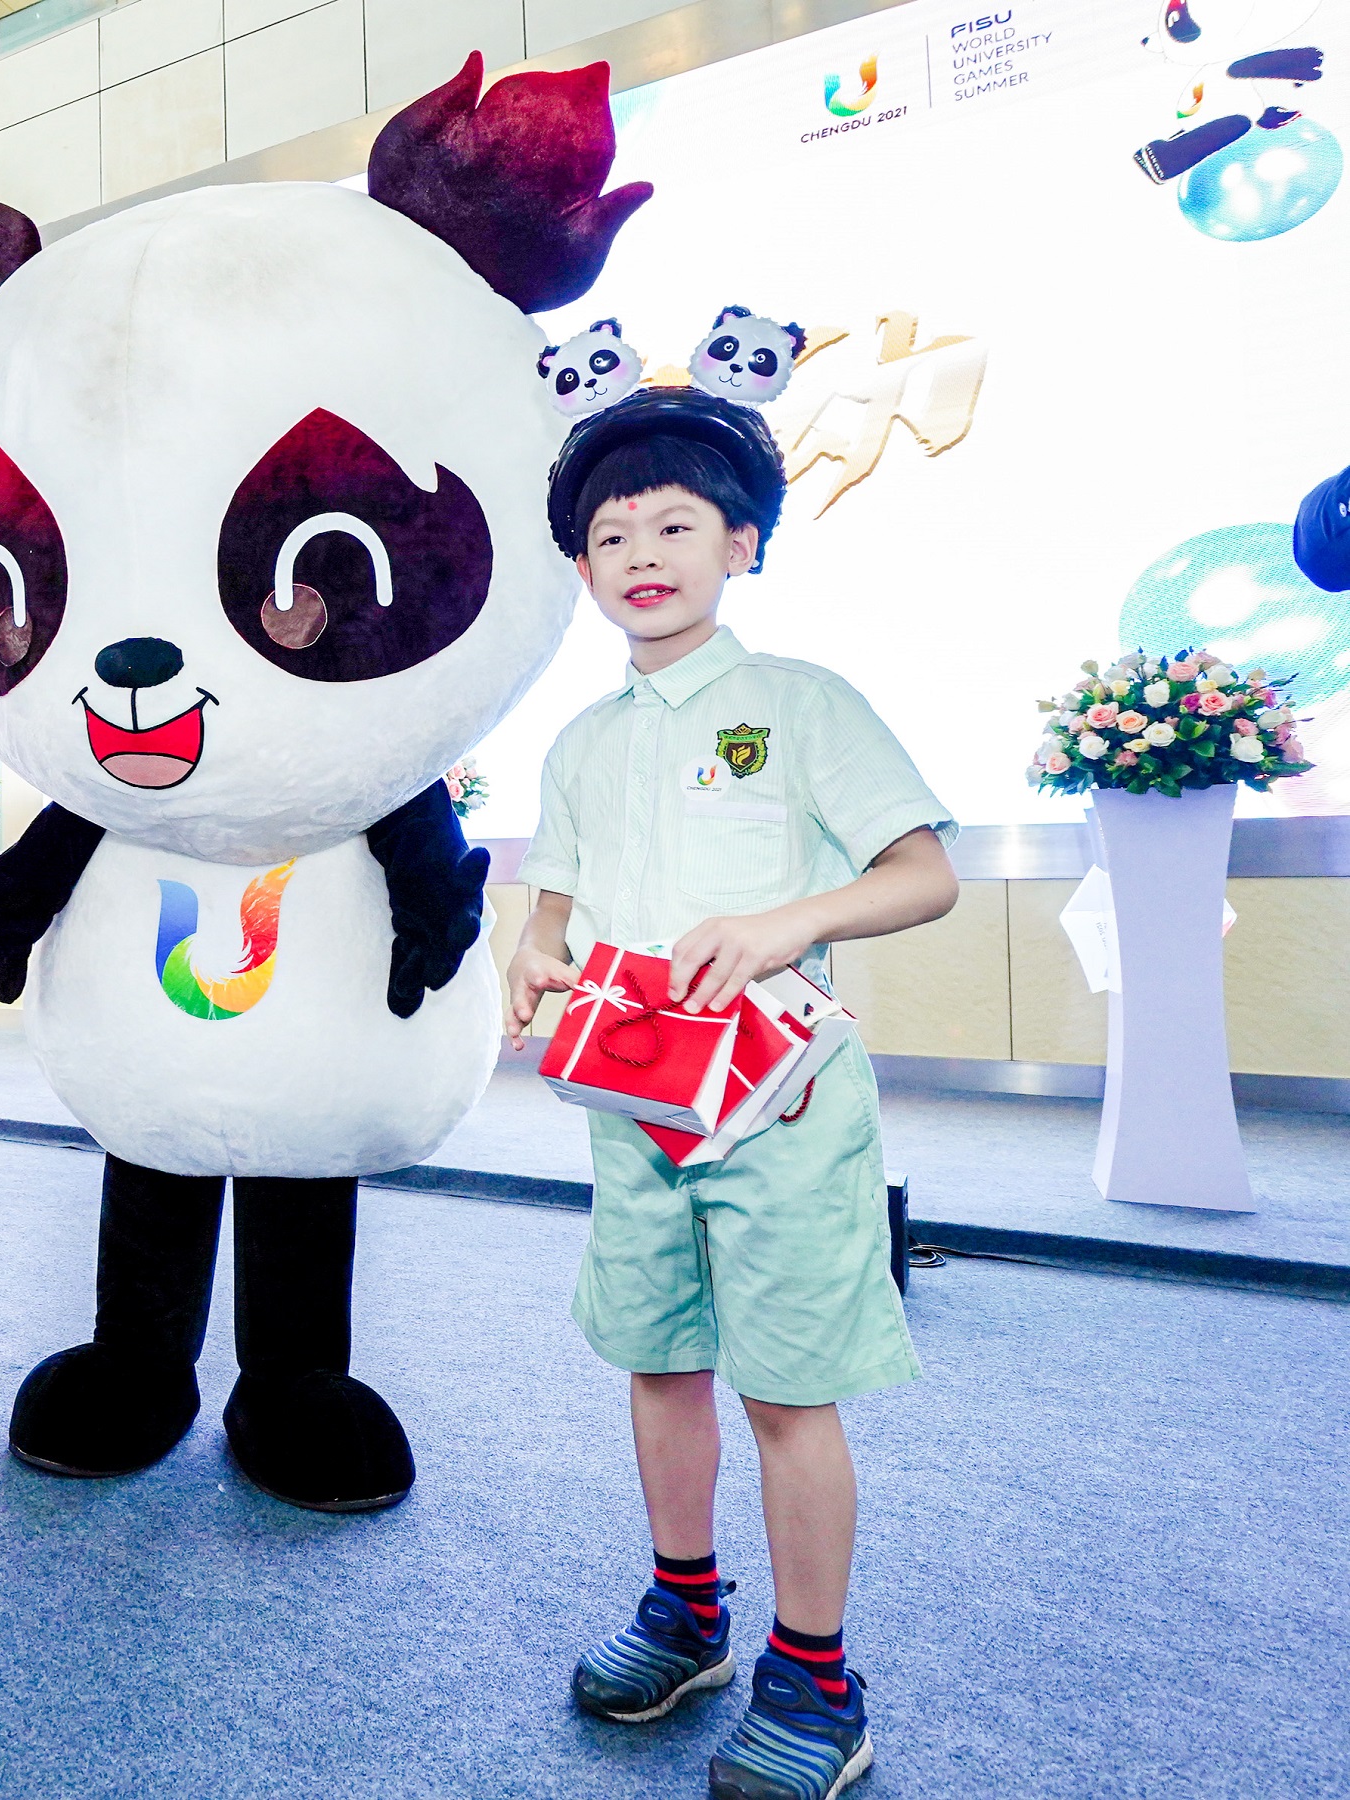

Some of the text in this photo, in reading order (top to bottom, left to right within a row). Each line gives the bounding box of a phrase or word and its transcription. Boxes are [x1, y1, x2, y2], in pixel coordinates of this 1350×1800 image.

[950, 9, 1012, 39] FISU
[952, 27, 1016, 54] WORLD
[953, 32, 1053, 70] UNIVERSITY
[953, 59, 1014, 86] GAMES
[954, 71, 1030, 102] SUMMER
[800, 105, 908, 144] CHENGDU 2021
